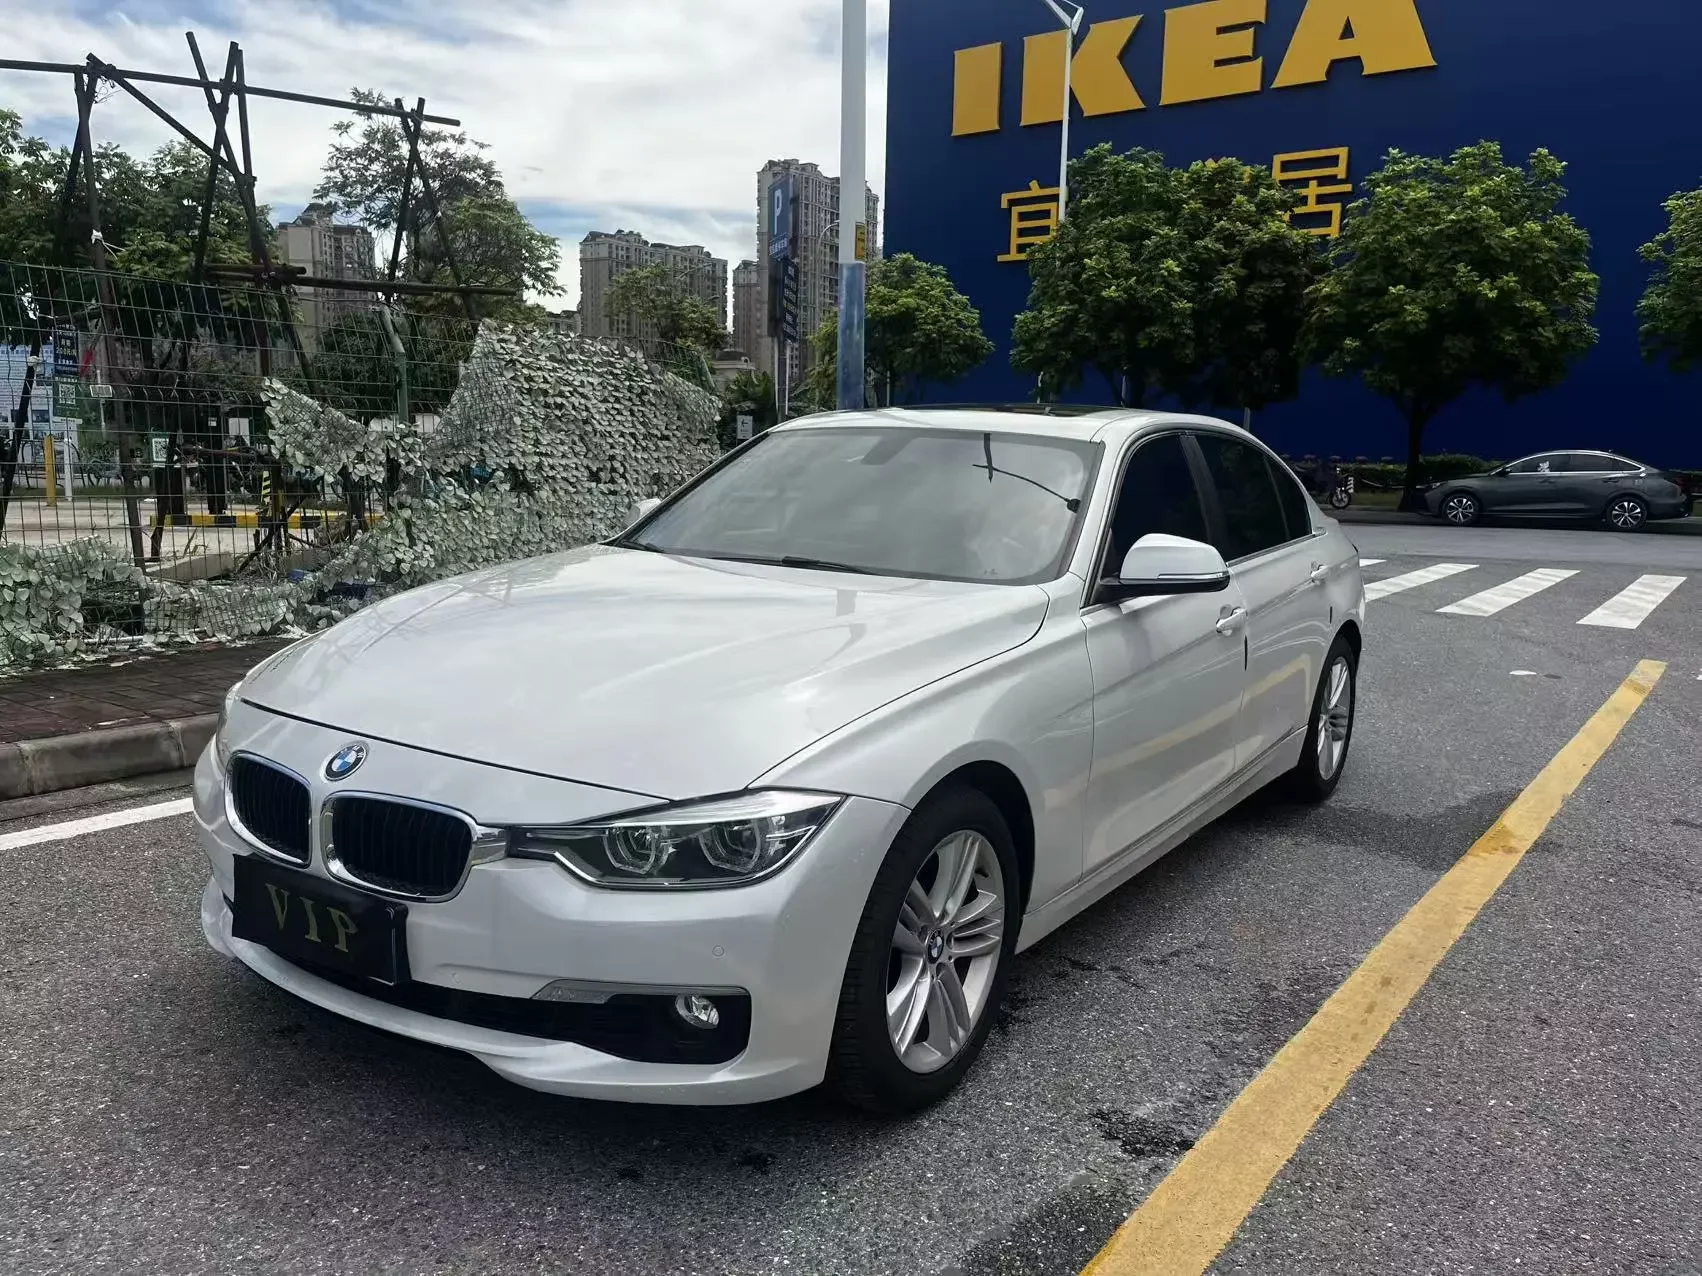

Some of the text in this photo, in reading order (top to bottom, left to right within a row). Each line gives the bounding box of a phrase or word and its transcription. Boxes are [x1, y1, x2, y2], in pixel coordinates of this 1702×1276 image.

[951, 0, 1437, 136] IKEA
[774, 189, 783, 236] P
[264, 882, 359, 953] VIP
